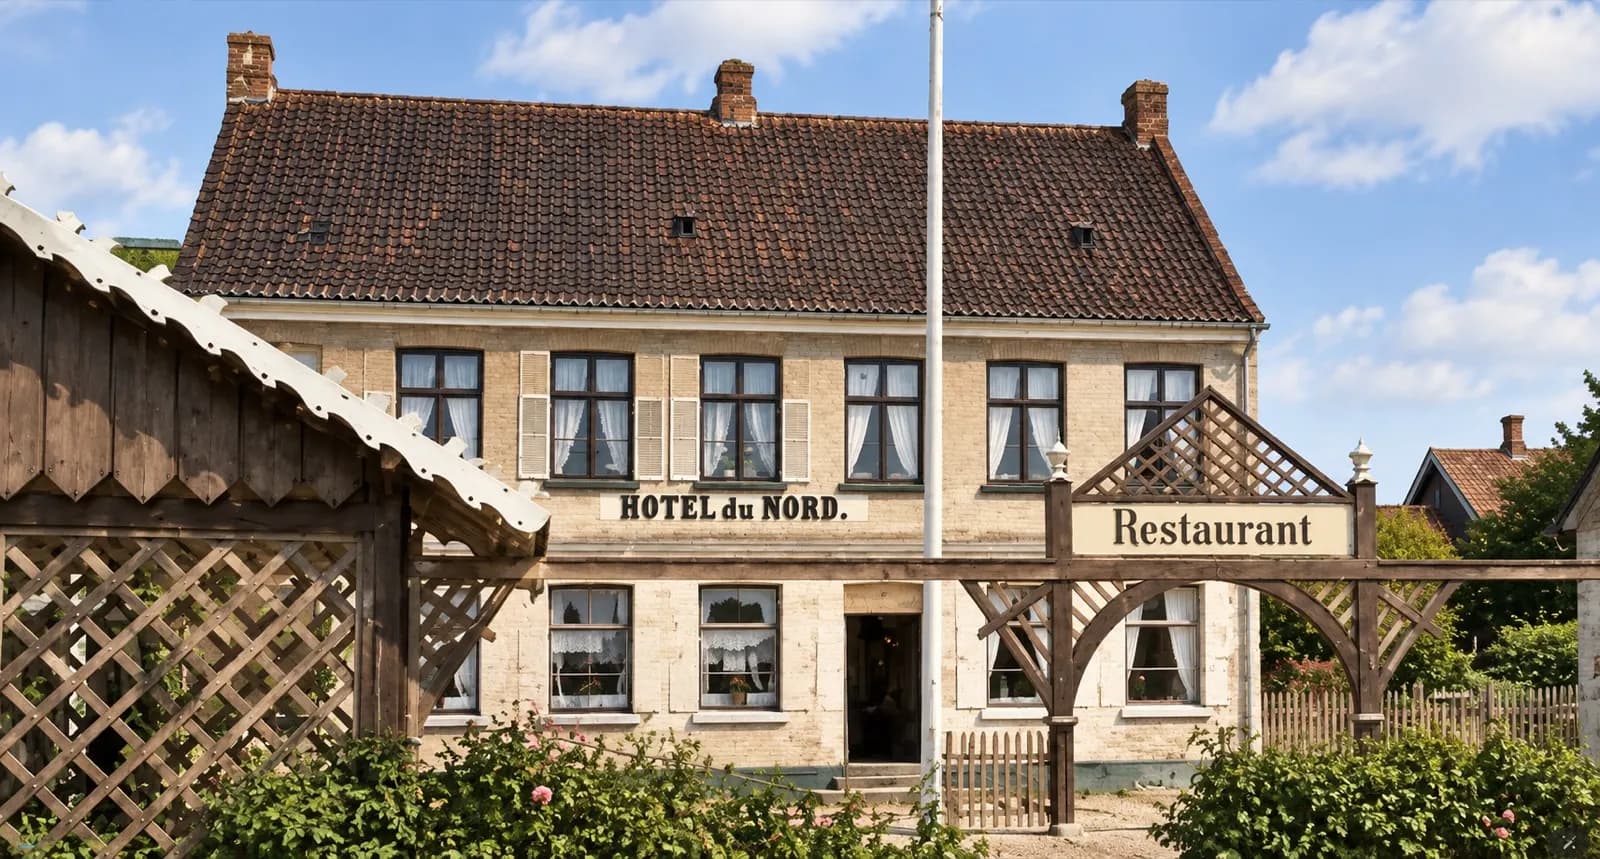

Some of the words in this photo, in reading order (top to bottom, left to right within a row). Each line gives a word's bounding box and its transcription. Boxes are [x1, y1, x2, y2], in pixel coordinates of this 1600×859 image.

[620, 494, 716, 520] HOTEL
[722, 497, 754, 520] du
[762, 495, 848, 521] NORD.
[1113, 508, 1313, 547] Restaurant
